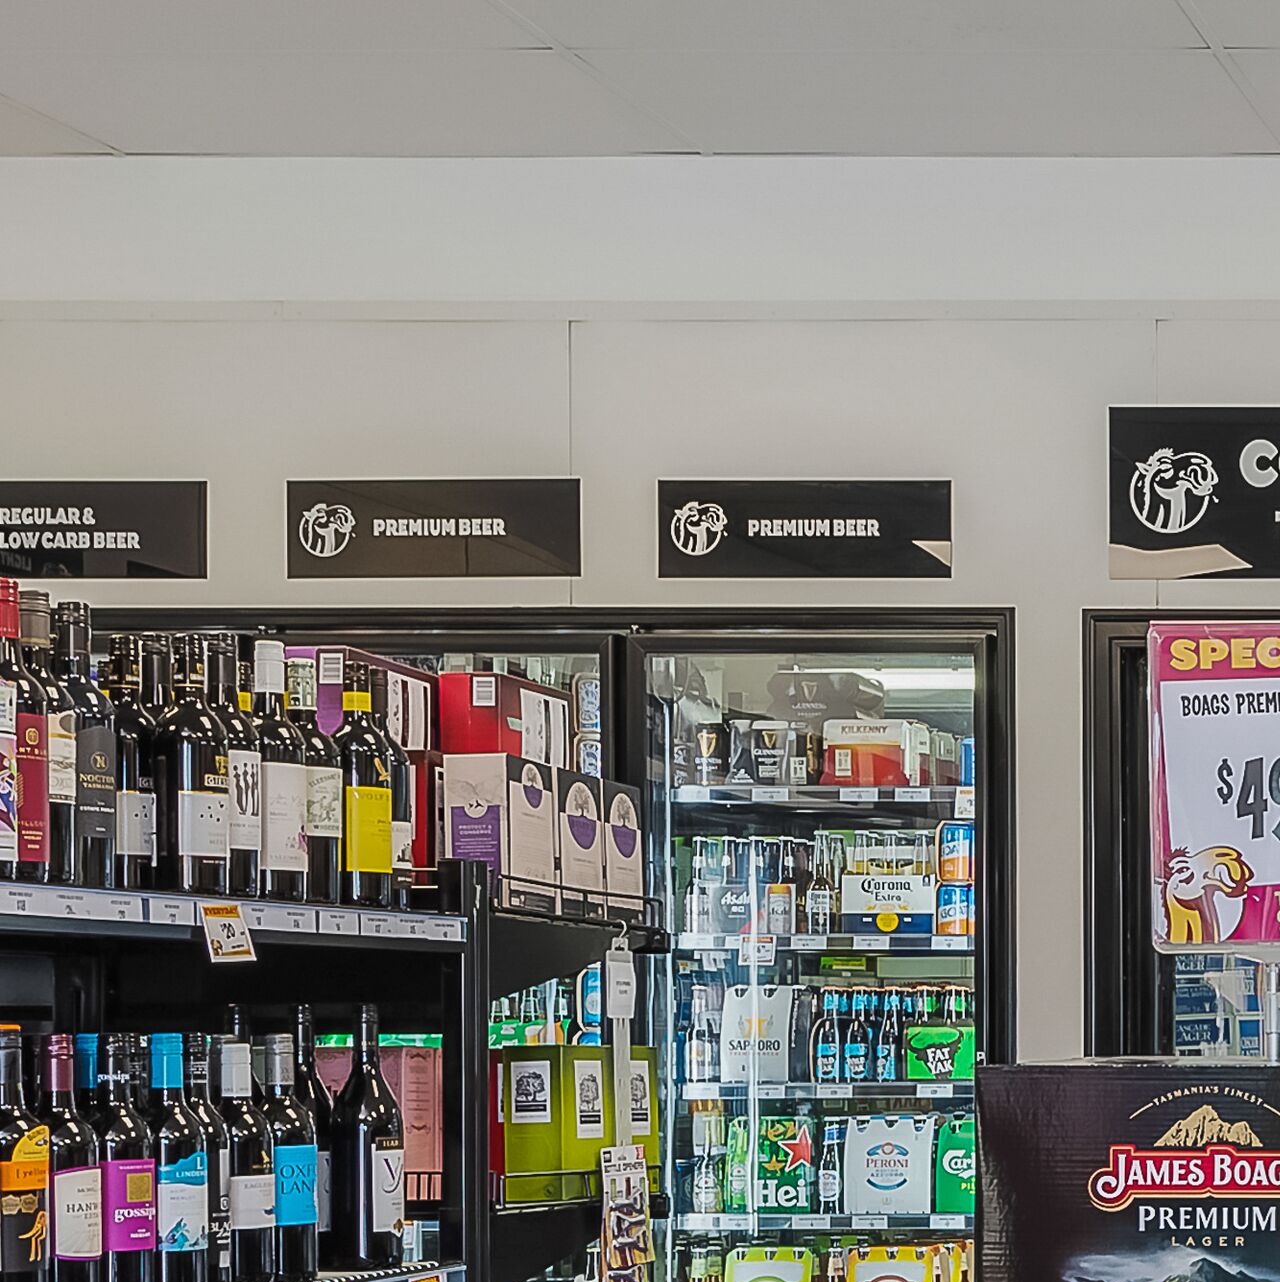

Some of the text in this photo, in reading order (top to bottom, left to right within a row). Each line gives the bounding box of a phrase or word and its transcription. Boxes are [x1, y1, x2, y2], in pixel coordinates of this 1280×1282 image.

[0, 507, 95, 525] REGULAR &
[373, 517, 506, 537] PREMIUM BEER
[748, 518, 880, 537] PREMIUM BEER
[0, 532, 140, 549] LOW CARB BEER
[1181, 695, 1230, 717] BOAGS
[840, 724, 888, 735] KILKENNY
[860, 877, 912, 895] Corona
[875, 892, 902, 902] Extra
[927, 1047, 951, 1064] FAT
[929, 1059, 953, 1074] YAK
[1153, 1085, 1264, 1107] TASMANIA'S FINEST
[865, 1156, 909, 1169] PERONI
[1096, 1152, 1204, 1196] JAMES
[1138, 1205, 1277, 1233] PREMIUM
[1171, 1235, 1245, 1247] LAGER
